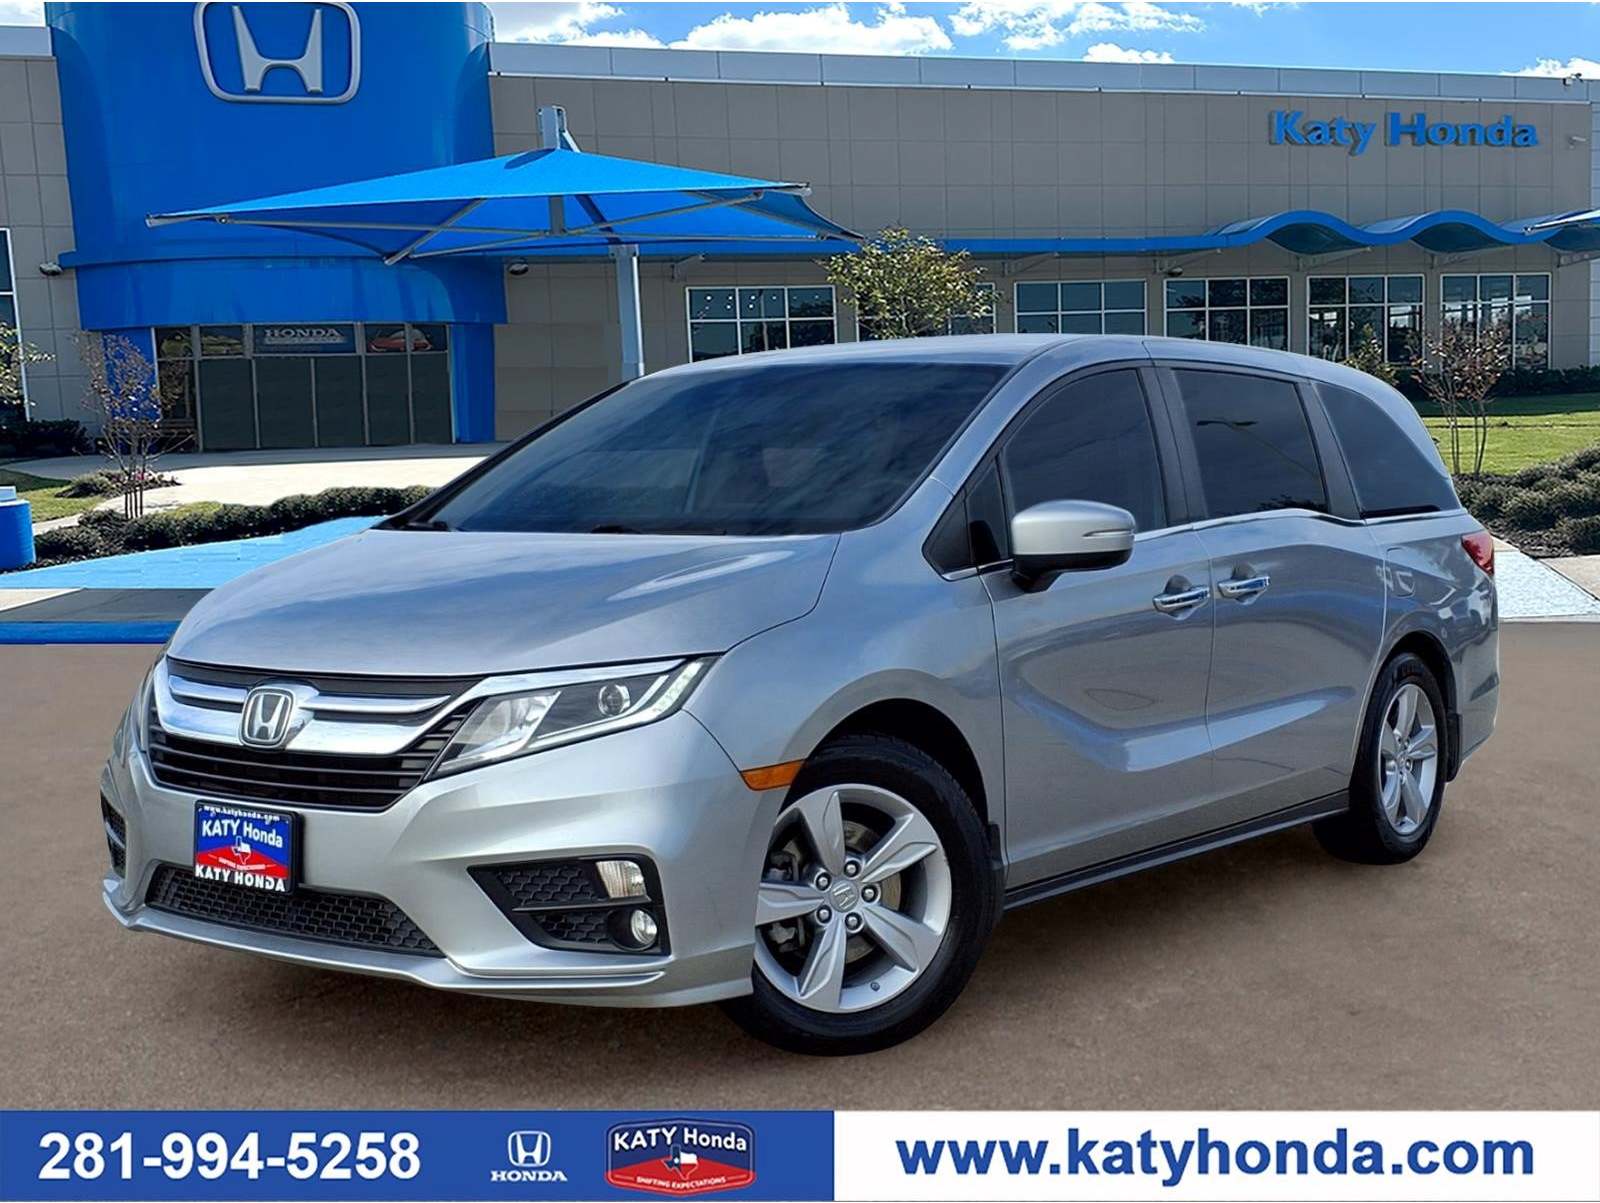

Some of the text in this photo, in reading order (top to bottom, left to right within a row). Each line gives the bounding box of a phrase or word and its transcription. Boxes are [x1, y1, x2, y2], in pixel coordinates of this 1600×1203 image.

[1270, 109, 1539, 156] Katy Honda
[264, 328, 341, 337] HONDA
[202, 819, 283, 848] KATY Honda
[195, 865, 285, 892] KATY HONDA
